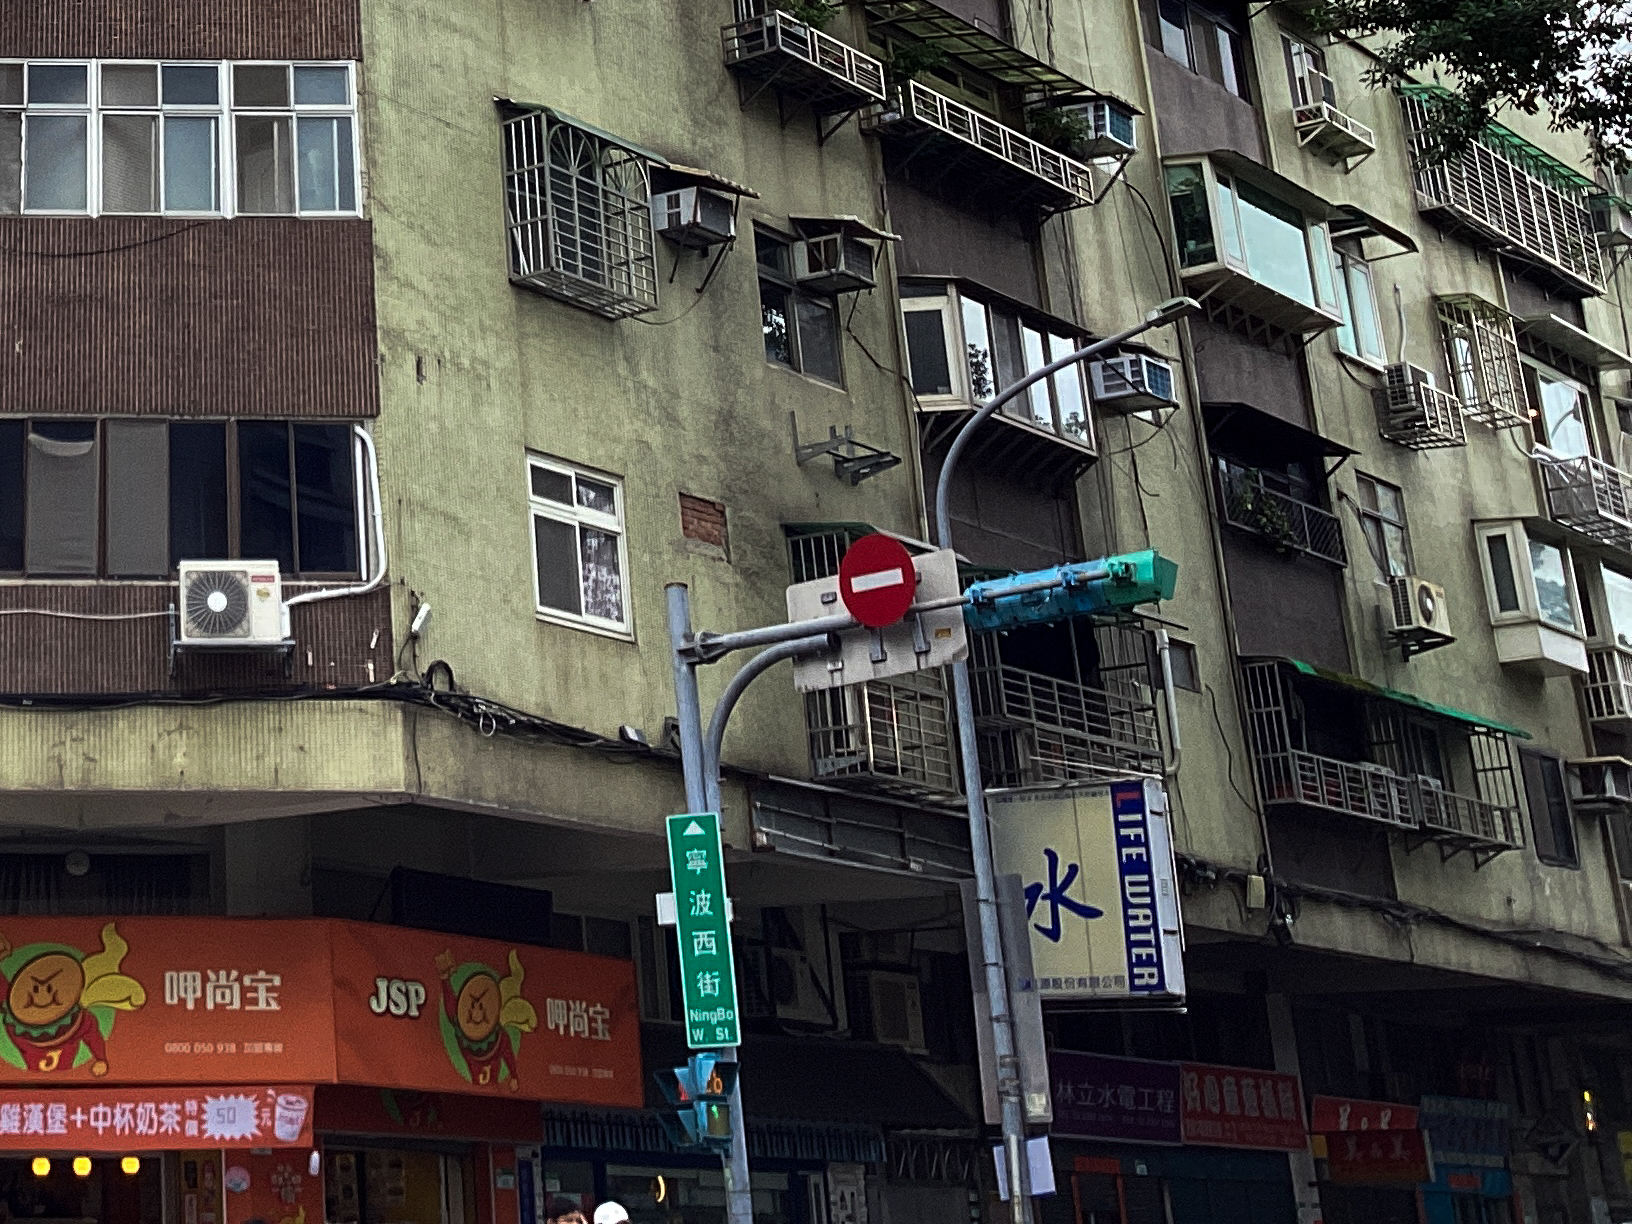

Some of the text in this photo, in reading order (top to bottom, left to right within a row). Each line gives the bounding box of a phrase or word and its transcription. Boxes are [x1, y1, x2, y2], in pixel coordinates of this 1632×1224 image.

[1115, 790, 1160, 989] LIFE WATER
[685, 848, 720, 998] 寧波西街
[164, 970, 282, 1011] 呷尚宝
[370, 977, 426, 1018] JSP
[546, 997, 612, 1042] 呷尚宝
[689, 1006, 734, 1025] NingBo
[691, 1027, 733, 1042] W. St.
[39, 1049, 61, 1072] J
[1055, 1078, 1176, 1115] 林立水電工程
[216, 1105, 237, 1125] 50
[260, 1108, 273, 1128] 元
